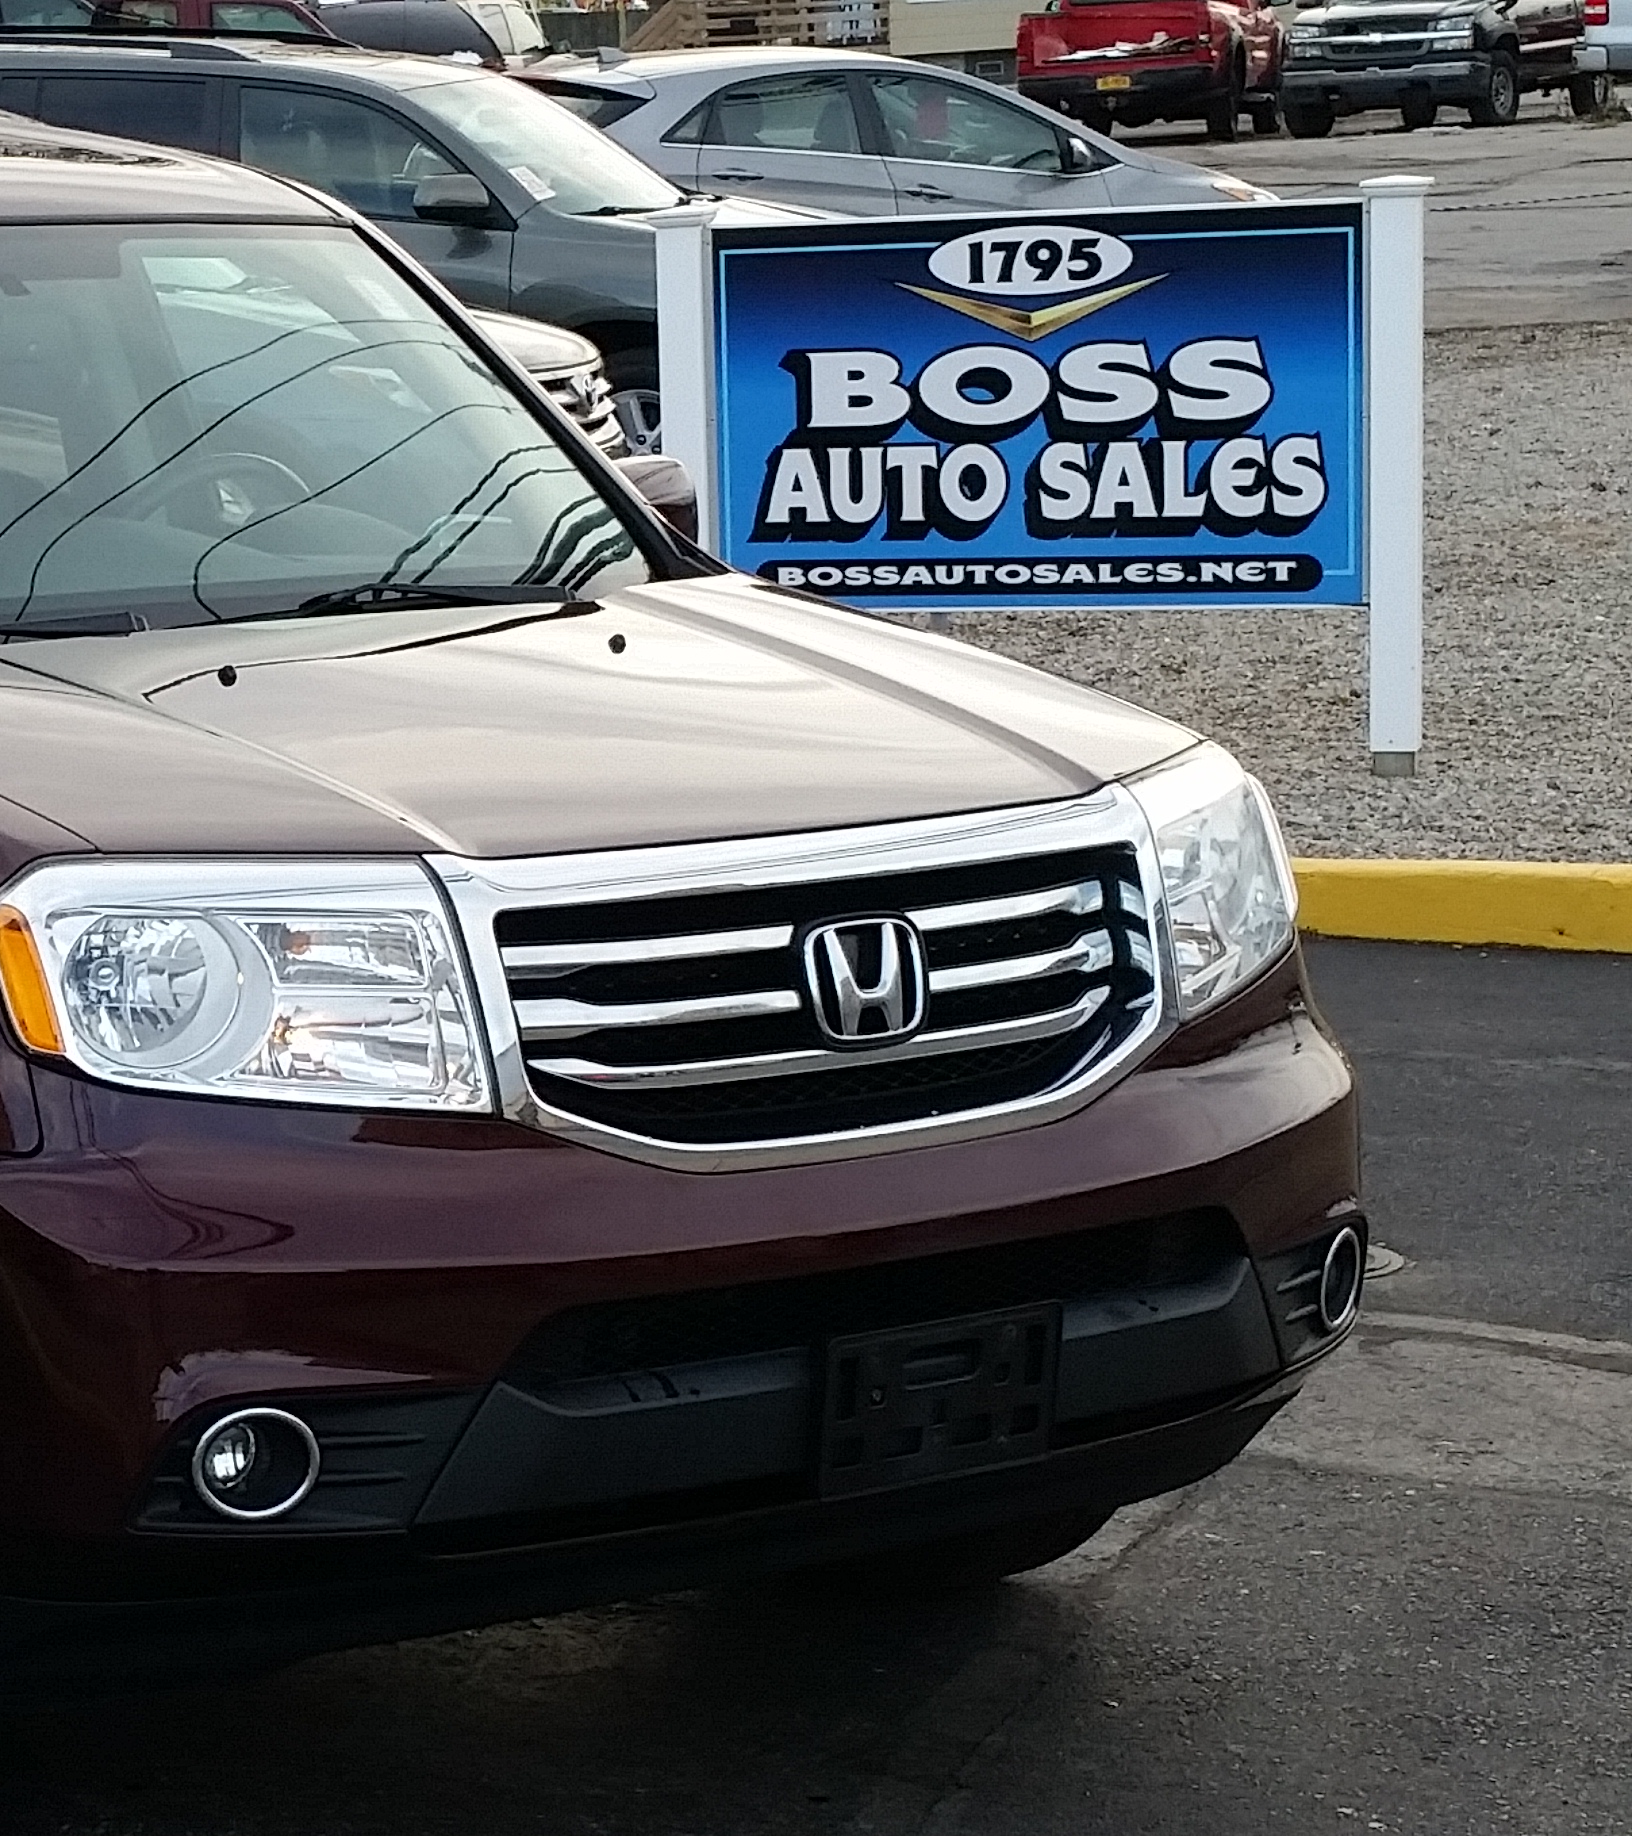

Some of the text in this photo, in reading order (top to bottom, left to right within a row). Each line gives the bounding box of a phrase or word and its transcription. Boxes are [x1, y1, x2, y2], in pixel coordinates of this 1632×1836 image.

[967, 237, 1104, 284] 1795
[802, 337, 1273, 428] BOSS
[764, 435, 1328, 523] AUTO SALES
[777, 560, 1299, 588] BOSSAUTOSALES.NET
